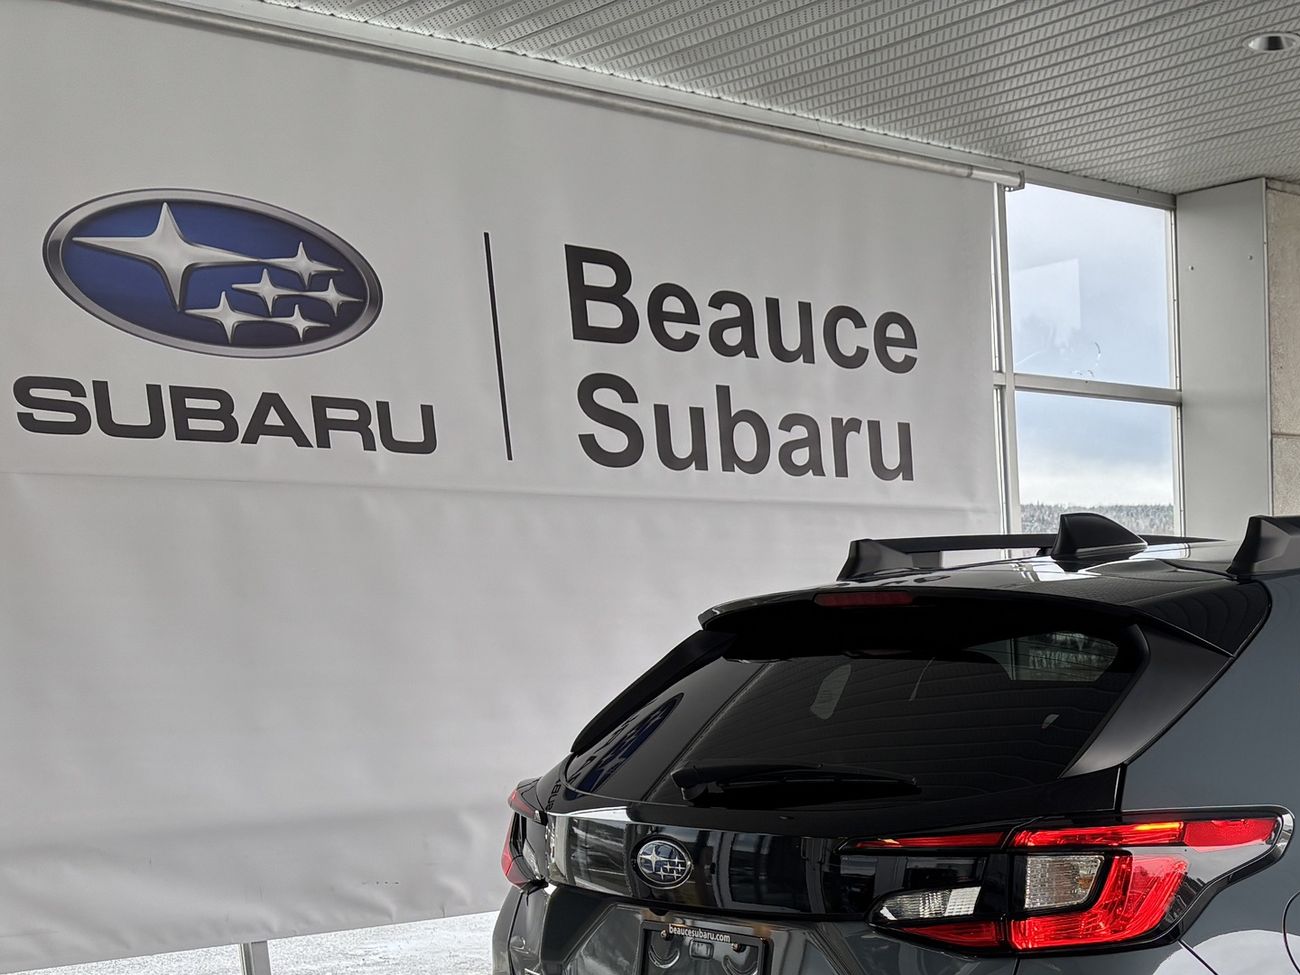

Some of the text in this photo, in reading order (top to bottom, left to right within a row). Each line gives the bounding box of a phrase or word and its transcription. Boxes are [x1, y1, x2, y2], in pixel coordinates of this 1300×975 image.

[564, 245, 919, 375] Beauce
[14, 376, 437, 455] SUBARU
[577, 374, 915, 481] Subaru
[668, 924, 731, 943] beaucesubaru.com
